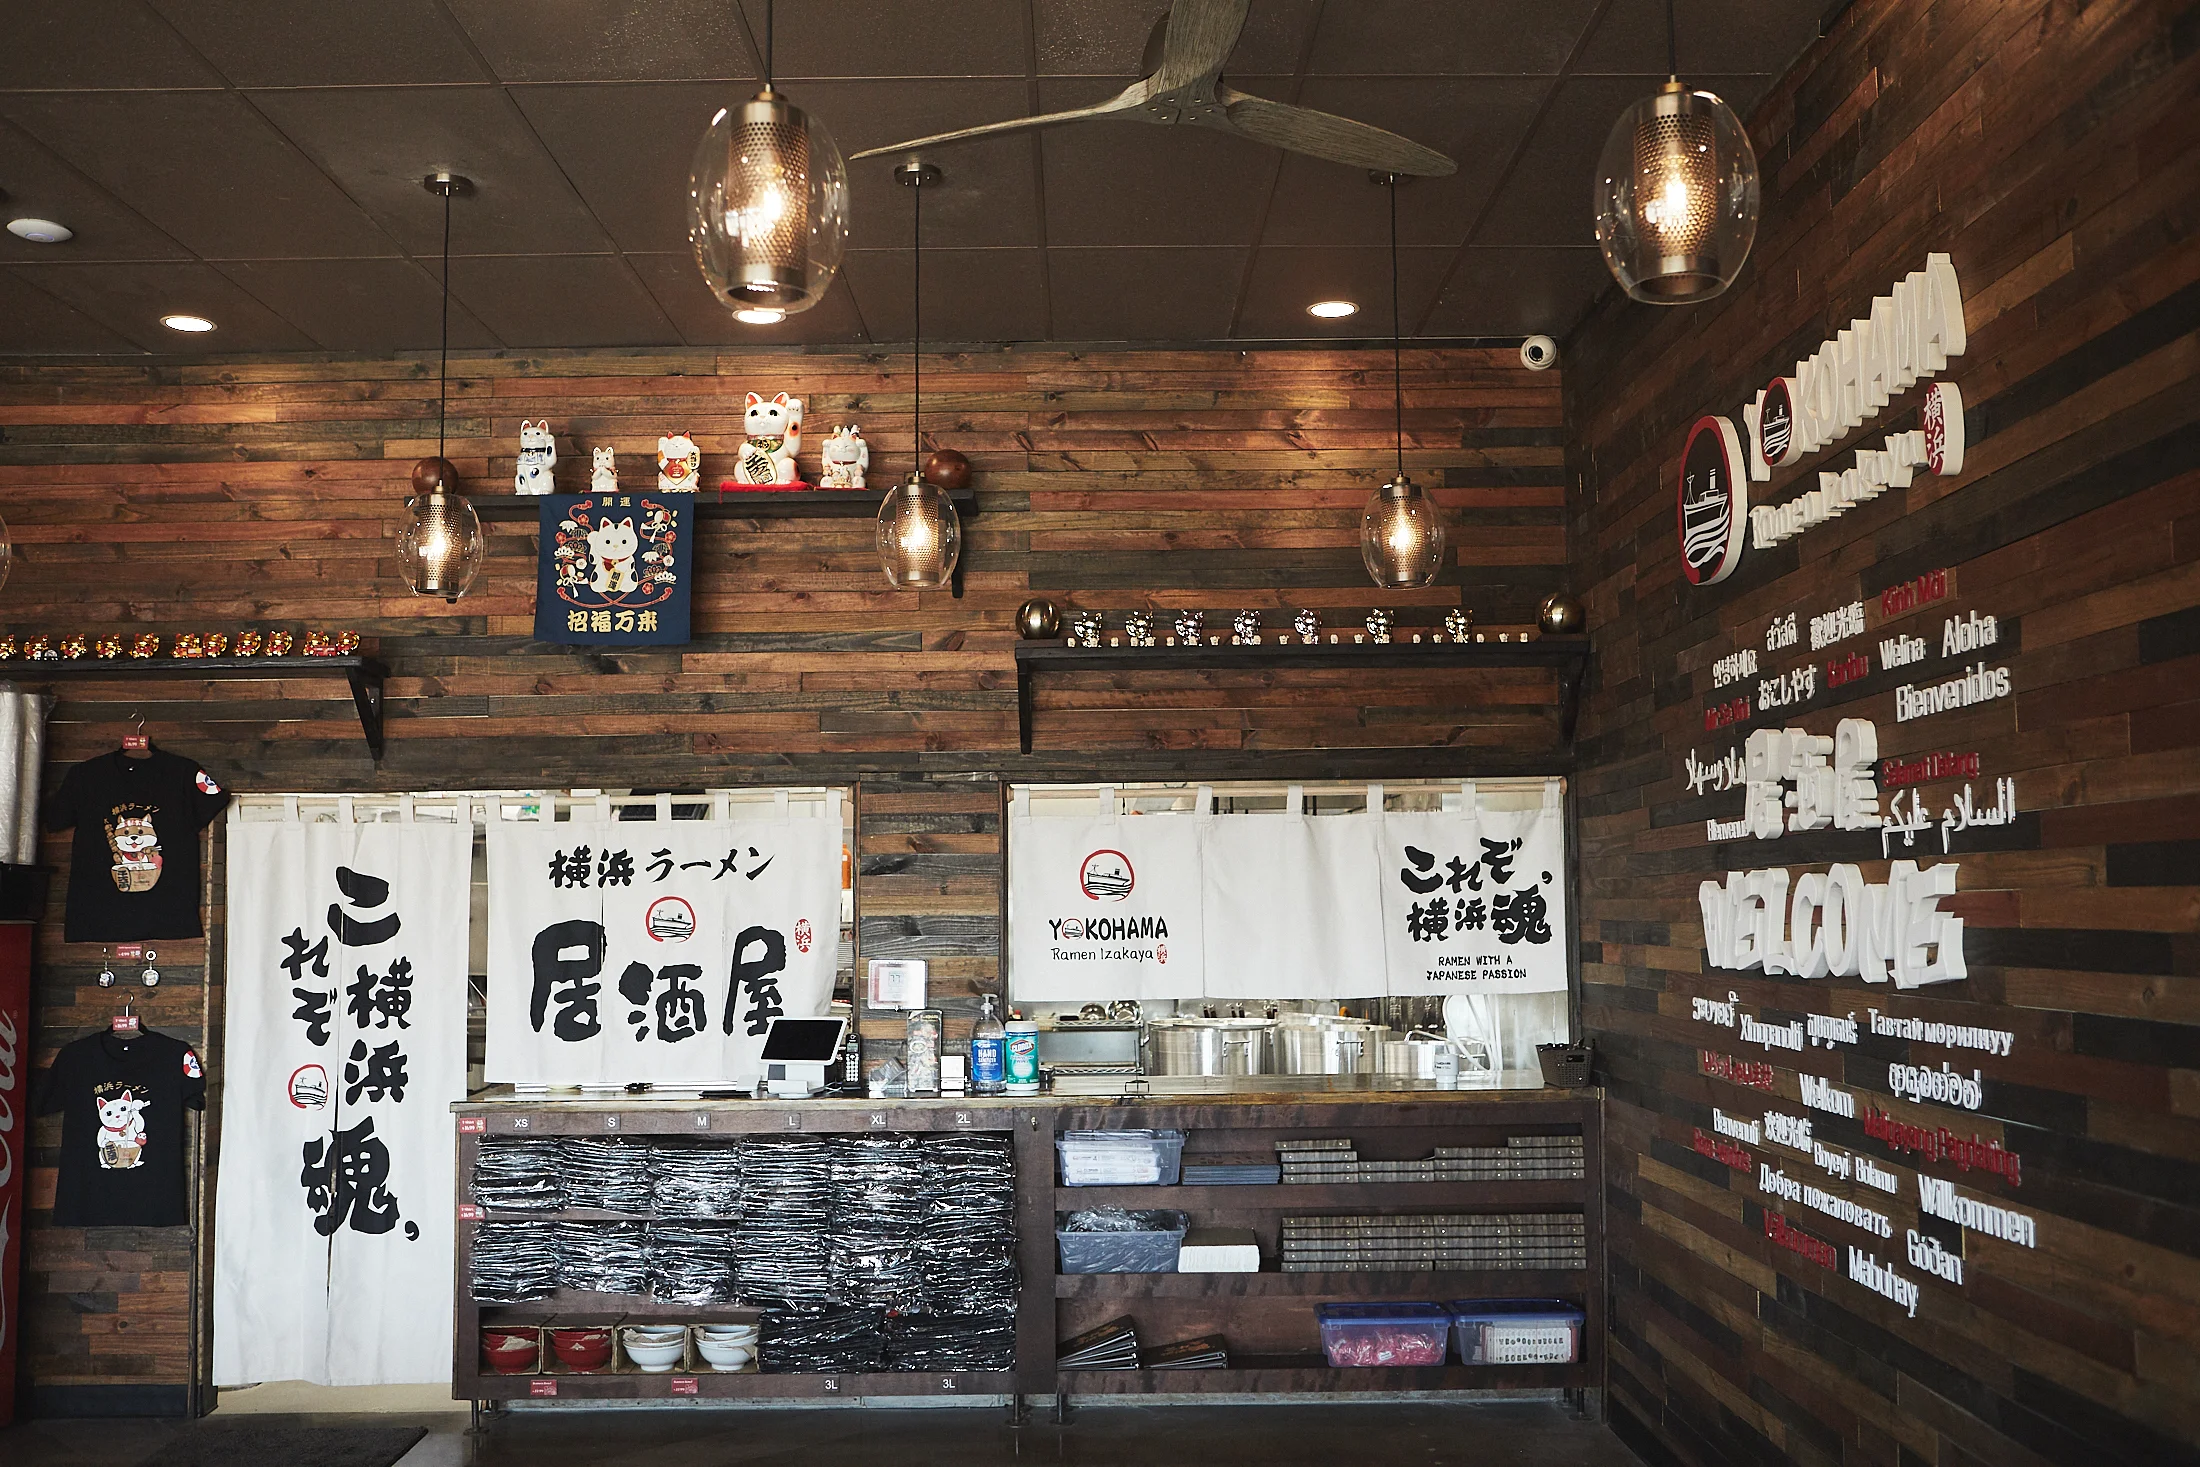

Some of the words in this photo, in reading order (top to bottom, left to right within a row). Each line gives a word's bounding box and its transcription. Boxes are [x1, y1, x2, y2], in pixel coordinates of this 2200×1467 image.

[1922, 386, 1946, 470] 横浜
[601, 496, 631, 507] 開運
[1749, 491, 1822, 549] Ramen
[1819, 430, 1928, 516] Izakaya
[567, 610, 657, 632] 招福万来
[1941, 610, 1998, 658] Aloha
[1879, 634, 1926, 670] Welina
[1896, 661, 2011, 722] Bienvenidos
[549, 845, 775, 888] 横浜ラーメン
[795, 918, 812, 953] 横浜
[1048, 916, 1168, 940] YOKOHAMA
[1699, 860, 1967, 989] WELCOME
[1051, 948, 1096, 960] Ramen
[1100, 947, 1154, 963] Izakaya
[1438, 956, 1471, 966] RAMEN
[1476, 955, 1500, 966] WITH
[1506, 955, 1513, 964] A
[530, 920, 786, 1043] 居酒屋
[1426, 970, 1477, 980] JAPANESE
[1482, 968, 1527, 979] PASSION
[1867, 1008, 1923, 1041] Тавтай
[977, 1049, 997, 1058] HAND
[1799, 1072, 1855, 1119] Welkom
[514, 1118, 528, 1127] XS
[608, 1117, 616, 1127] S
[697, 1116, 707, 1126] M
[788, 1116, 796, 1126] L
[871, 1115, 886, 1125] XL
[957, 1114, 970, 1124] 2L
[1712, 1107, 1761, 1145] Benvenuti
[1803, 1185, 1893, 1239] пожаловать
[1917, 1174, 2036, 1249] Willkommen
[1849, 1245, 1919, 1318] Mabuhay
[824, 1379, 838, 1390] 3L
[942, 1378, 955, 1389] 3L
